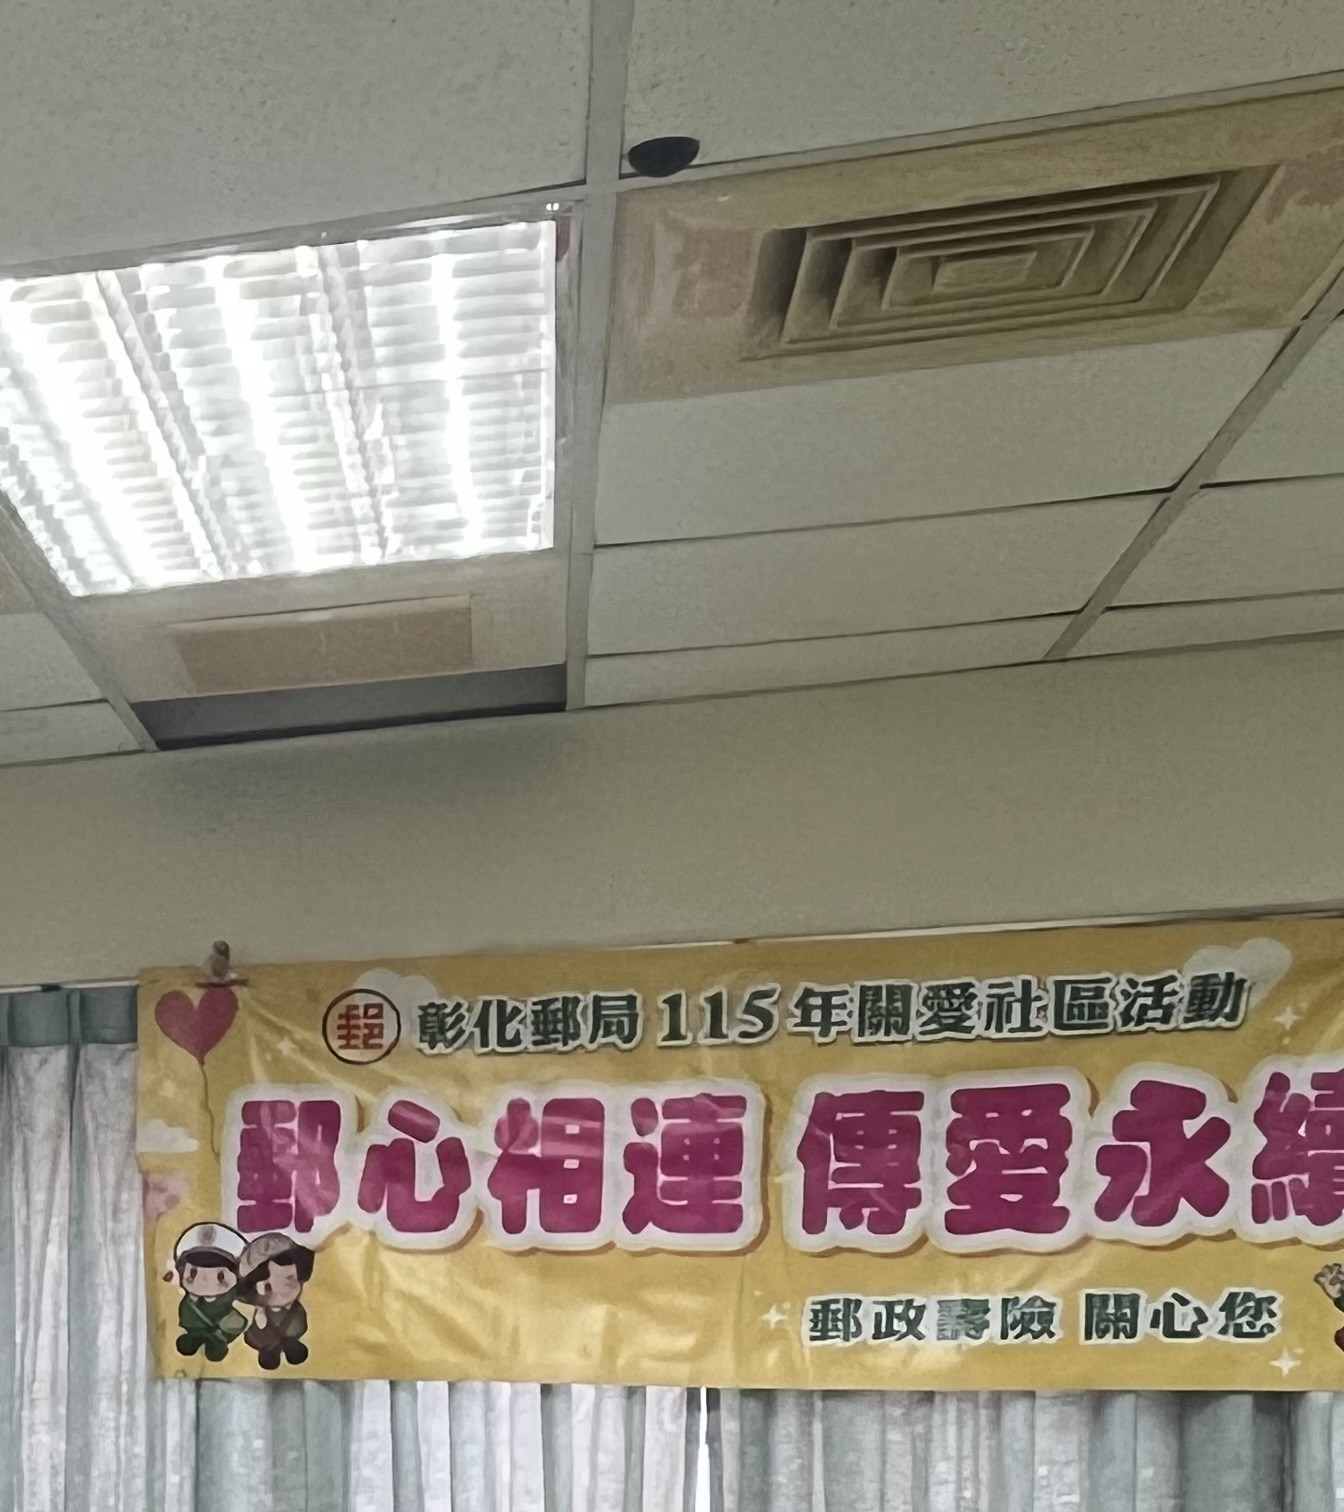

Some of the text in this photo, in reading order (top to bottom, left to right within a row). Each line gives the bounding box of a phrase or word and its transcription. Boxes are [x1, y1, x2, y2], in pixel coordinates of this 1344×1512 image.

[808, 1290, 1278, 1341] 郵政壽險 關心您
